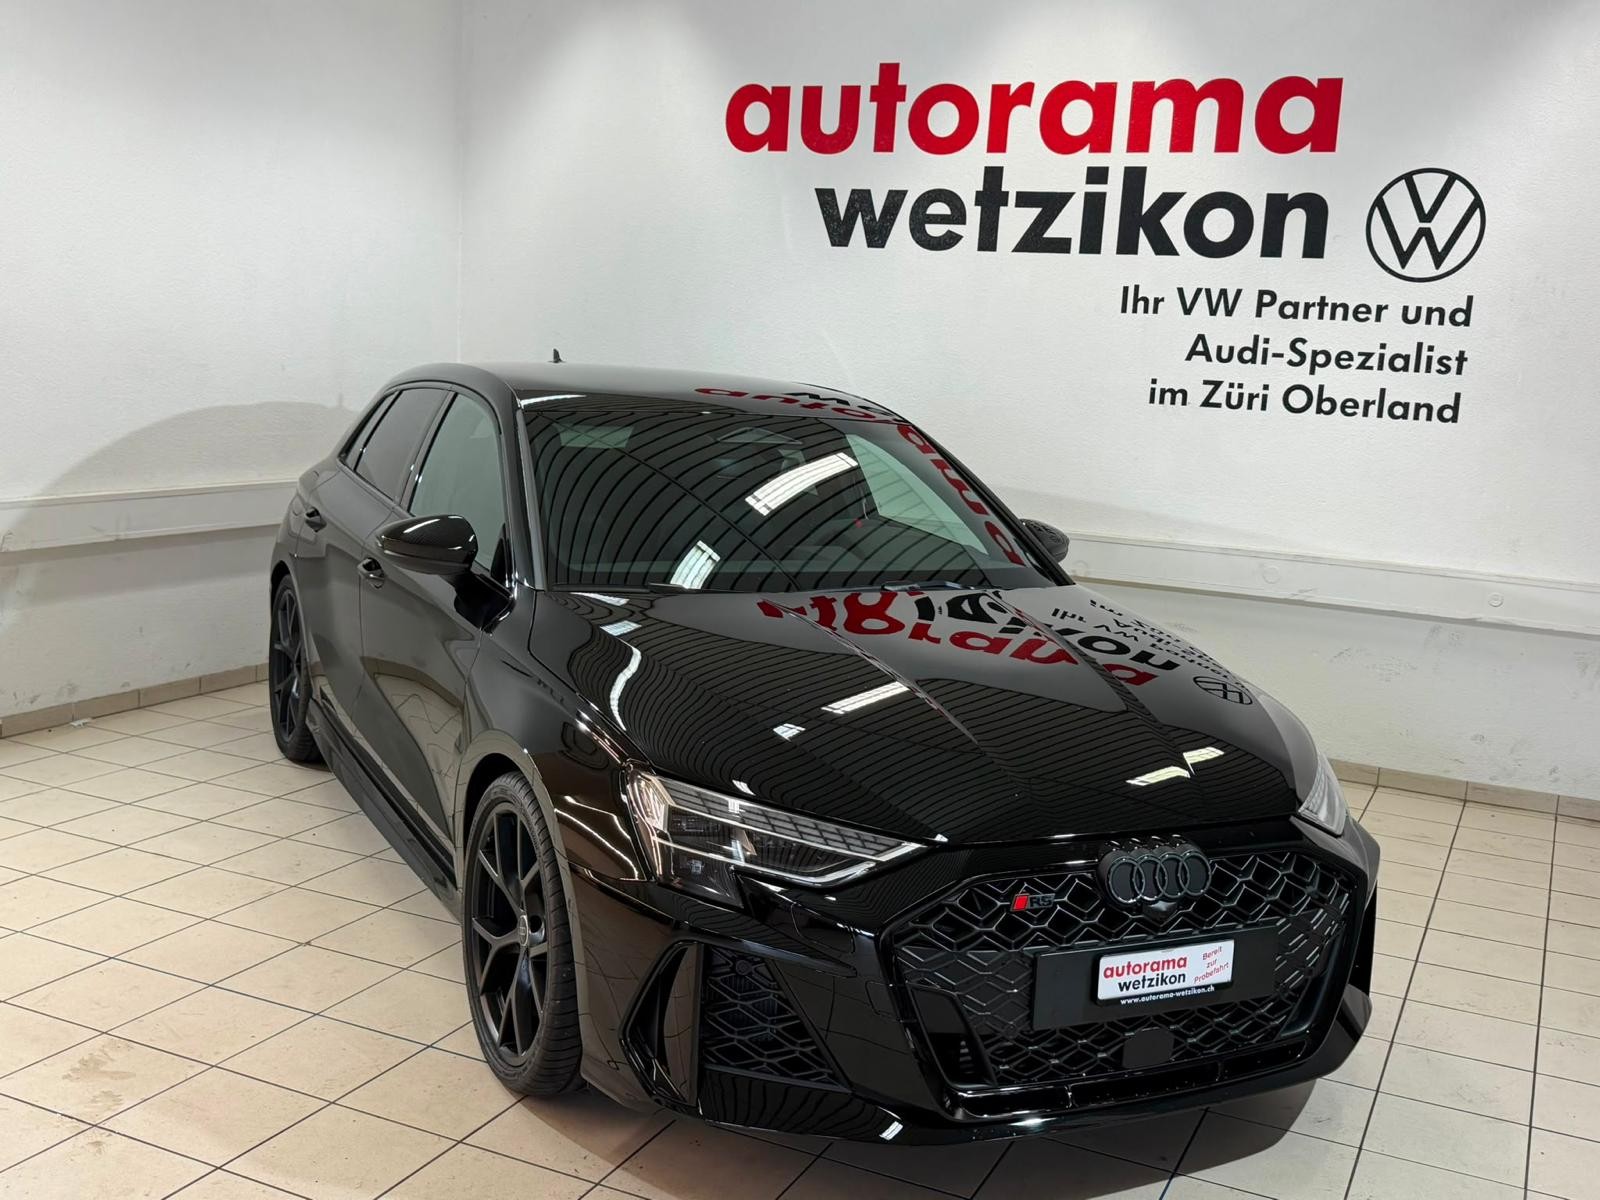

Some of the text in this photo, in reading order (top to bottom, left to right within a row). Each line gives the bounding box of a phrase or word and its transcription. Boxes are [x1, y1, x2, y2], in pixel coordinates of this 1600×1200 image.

[726, 63, 1343, 155] autorama
[815, 165, 1329, 258] wetzikon
[1121, 285, 1474, 327] Ihr VW Partner und
[1185, 334, 1468, 376] Audi-Spezialist
[1149, 379, 1462, 424] im Züri Oberland
[1202, 946, 1222, 960] Bereit
[1206, 959, 1217, 969] zur
[1103, 956, 1188, 979] autorama
[1194, 962, 1229, 983] Probefahrt
[1118, 972, 1186, 992] wetzikon
[1120, 984, 1215, 1005] www.autorama-wetzikon.ch
